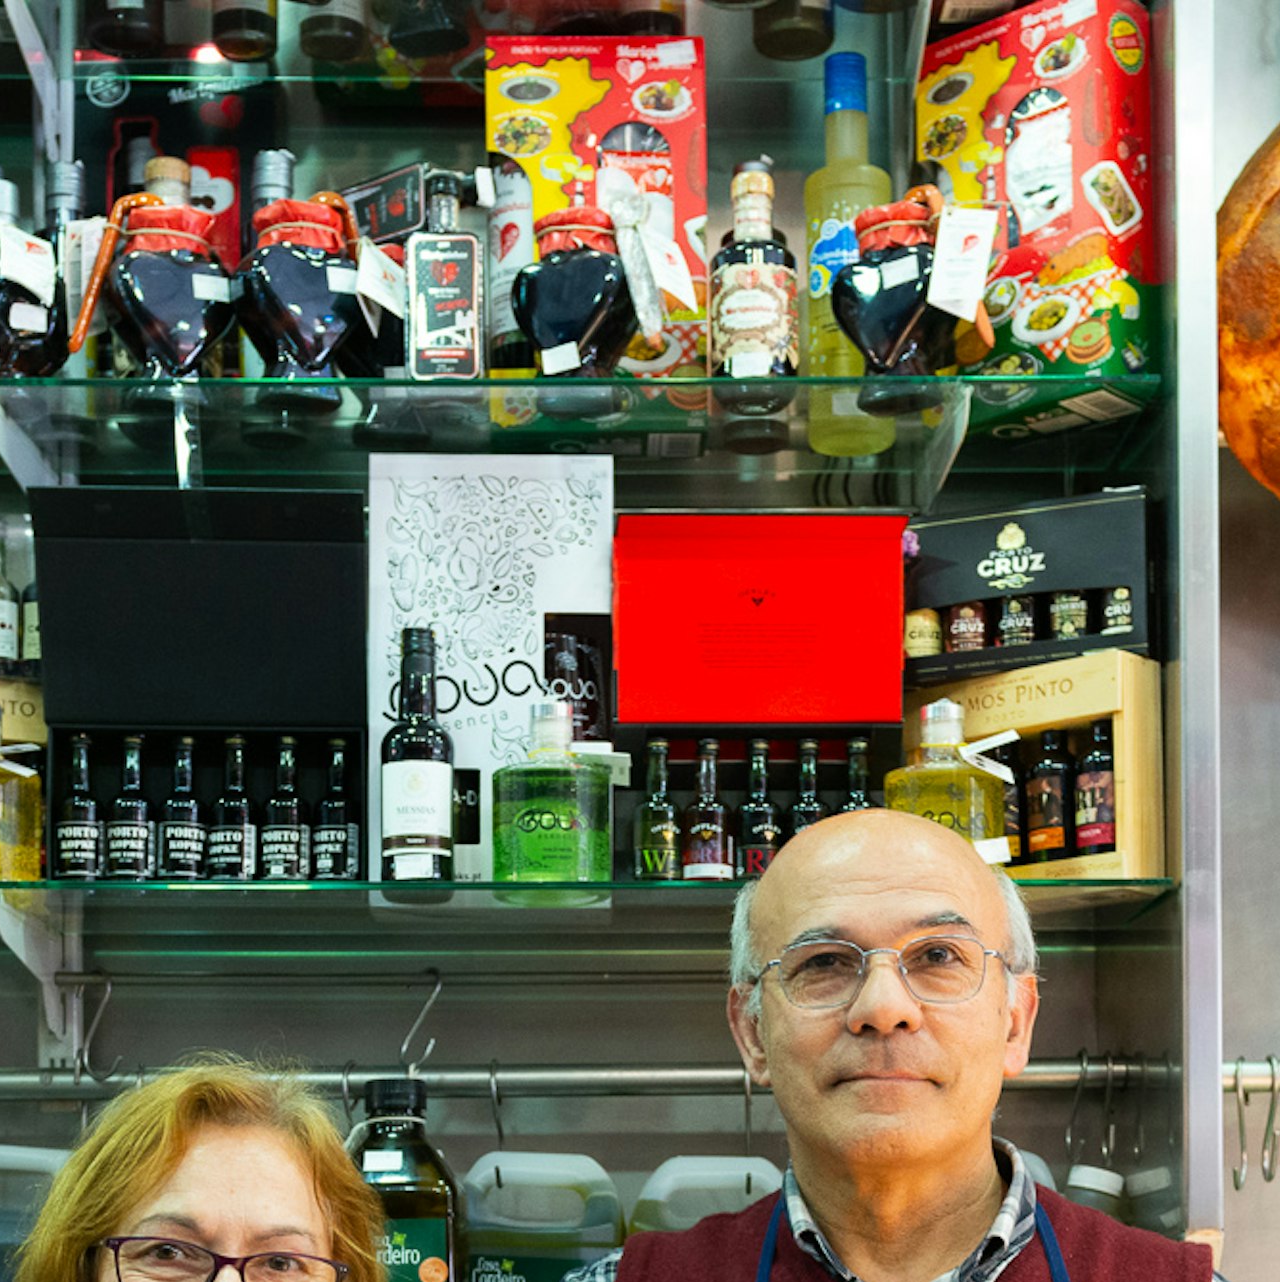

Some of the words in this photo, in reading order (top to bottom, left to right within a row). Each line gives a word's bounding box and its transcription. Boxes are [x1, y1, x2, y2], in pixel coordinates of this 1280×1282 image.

[989, 546, 1034, 559] PORTO
[976, 552, 1047, 578] CRUZ
[950, 620, 986, 635] CRUZ
[998, 616, 1035, 631] CRUZ
[1015, 677, 1075, 706] PINTO
[57, 826, 99, 839] PORTO
[107, 826, 149, 839] PORTO
[166, 826, 206, 841] PORTO
